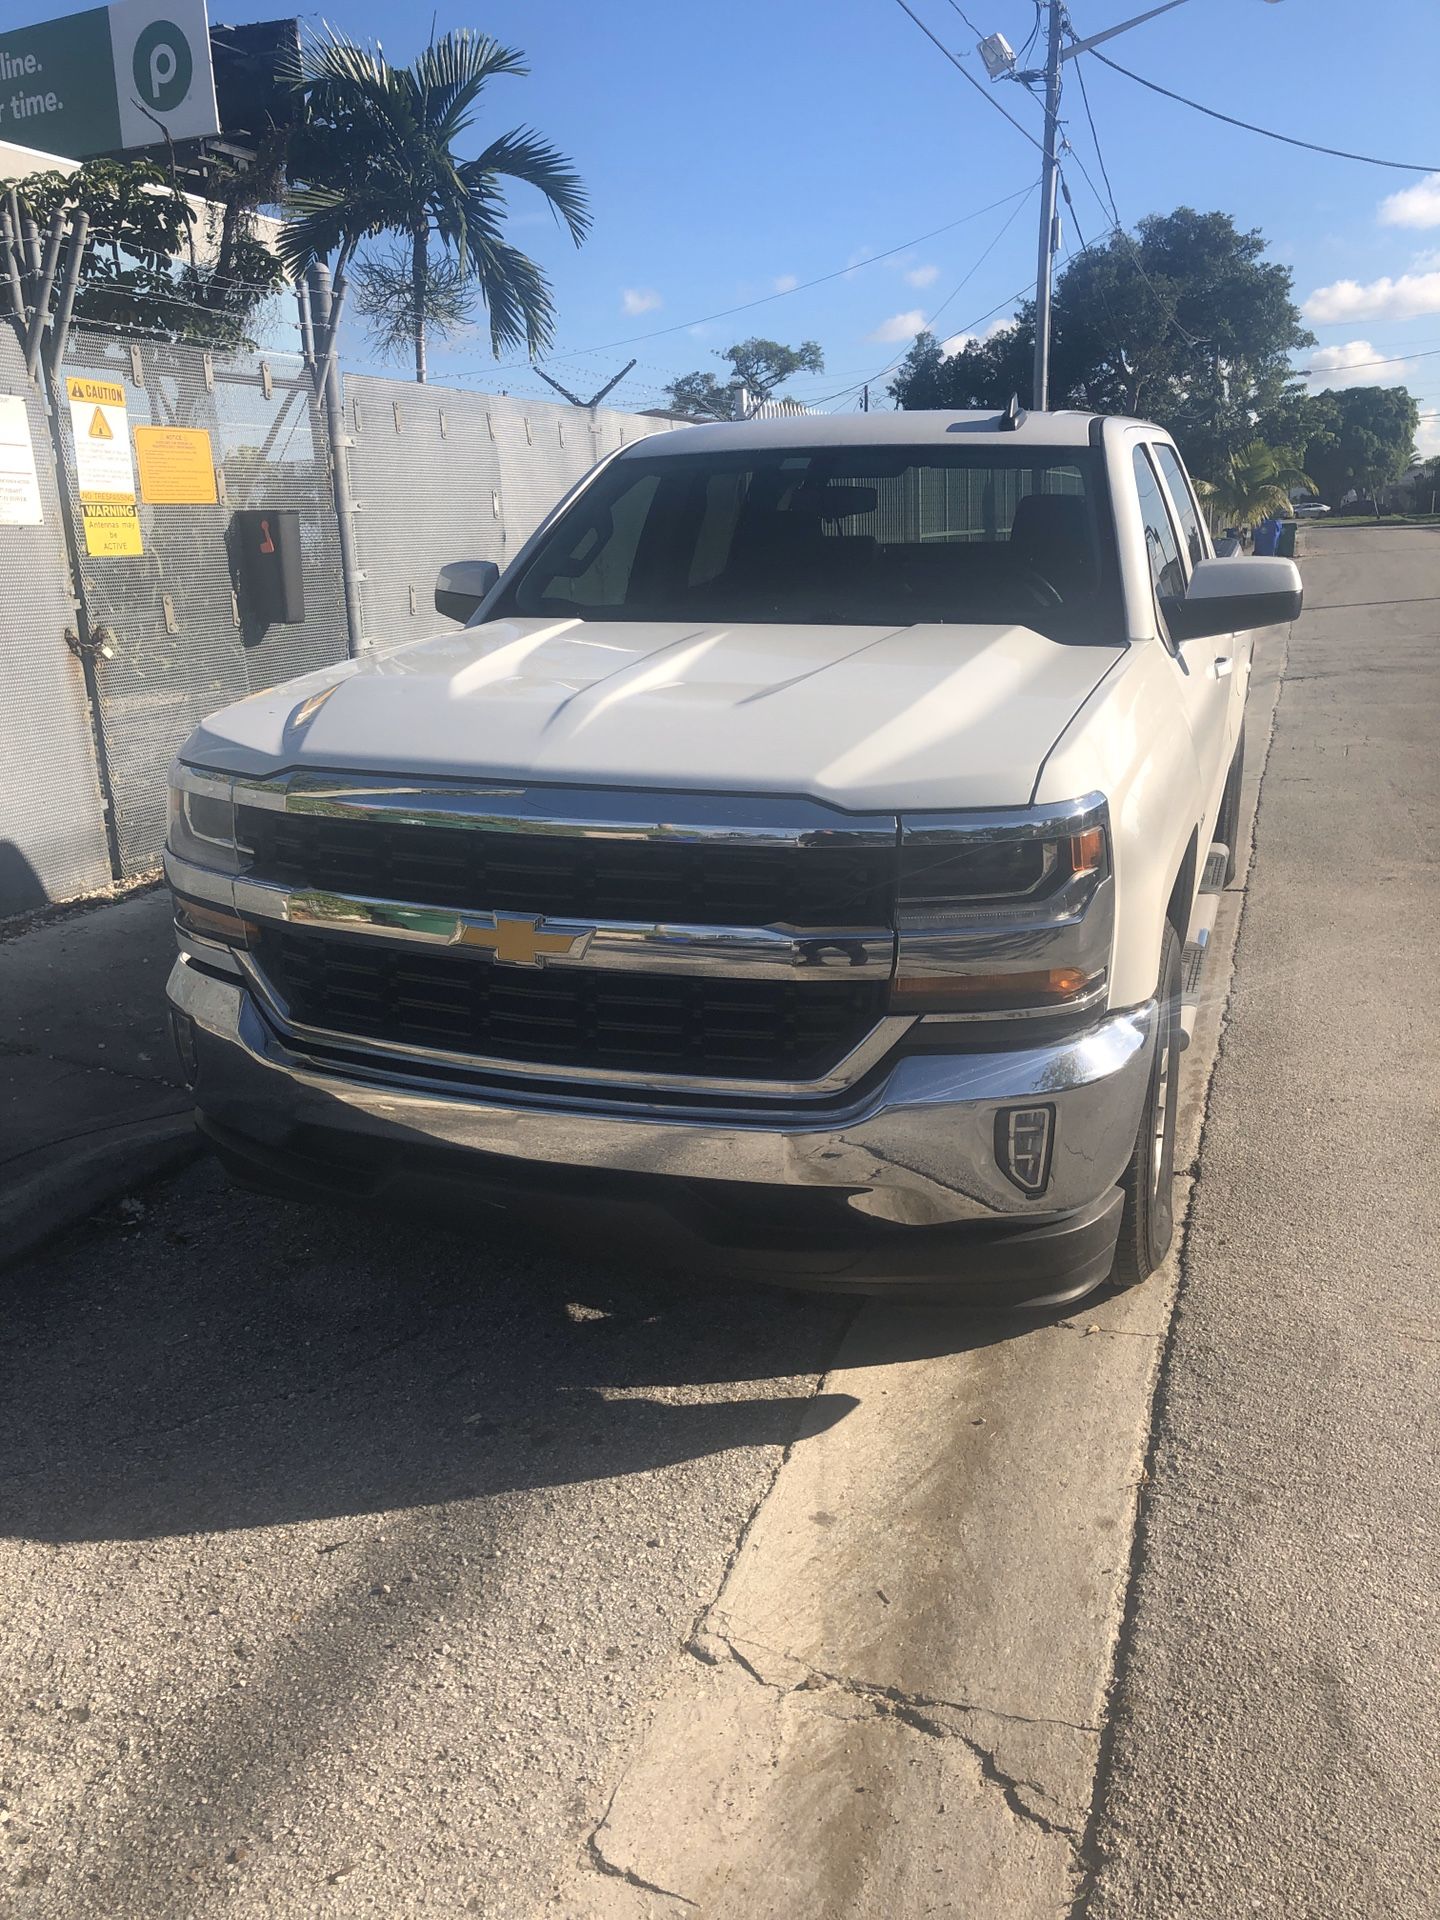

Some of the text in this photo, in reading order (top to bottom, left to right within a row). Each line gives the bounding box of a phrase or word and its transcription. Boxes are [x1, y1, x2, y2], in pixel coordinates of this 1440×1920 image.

[10, 91, 63, 119] time.
[85, 384, 123, 402] CAUTION
[85, 505, 135, 517] WARNING
[89, 520, 136, 530] Antennas may
[109, 531, 118, 539] be
[103, 542, 128, 551] ACTIVE
